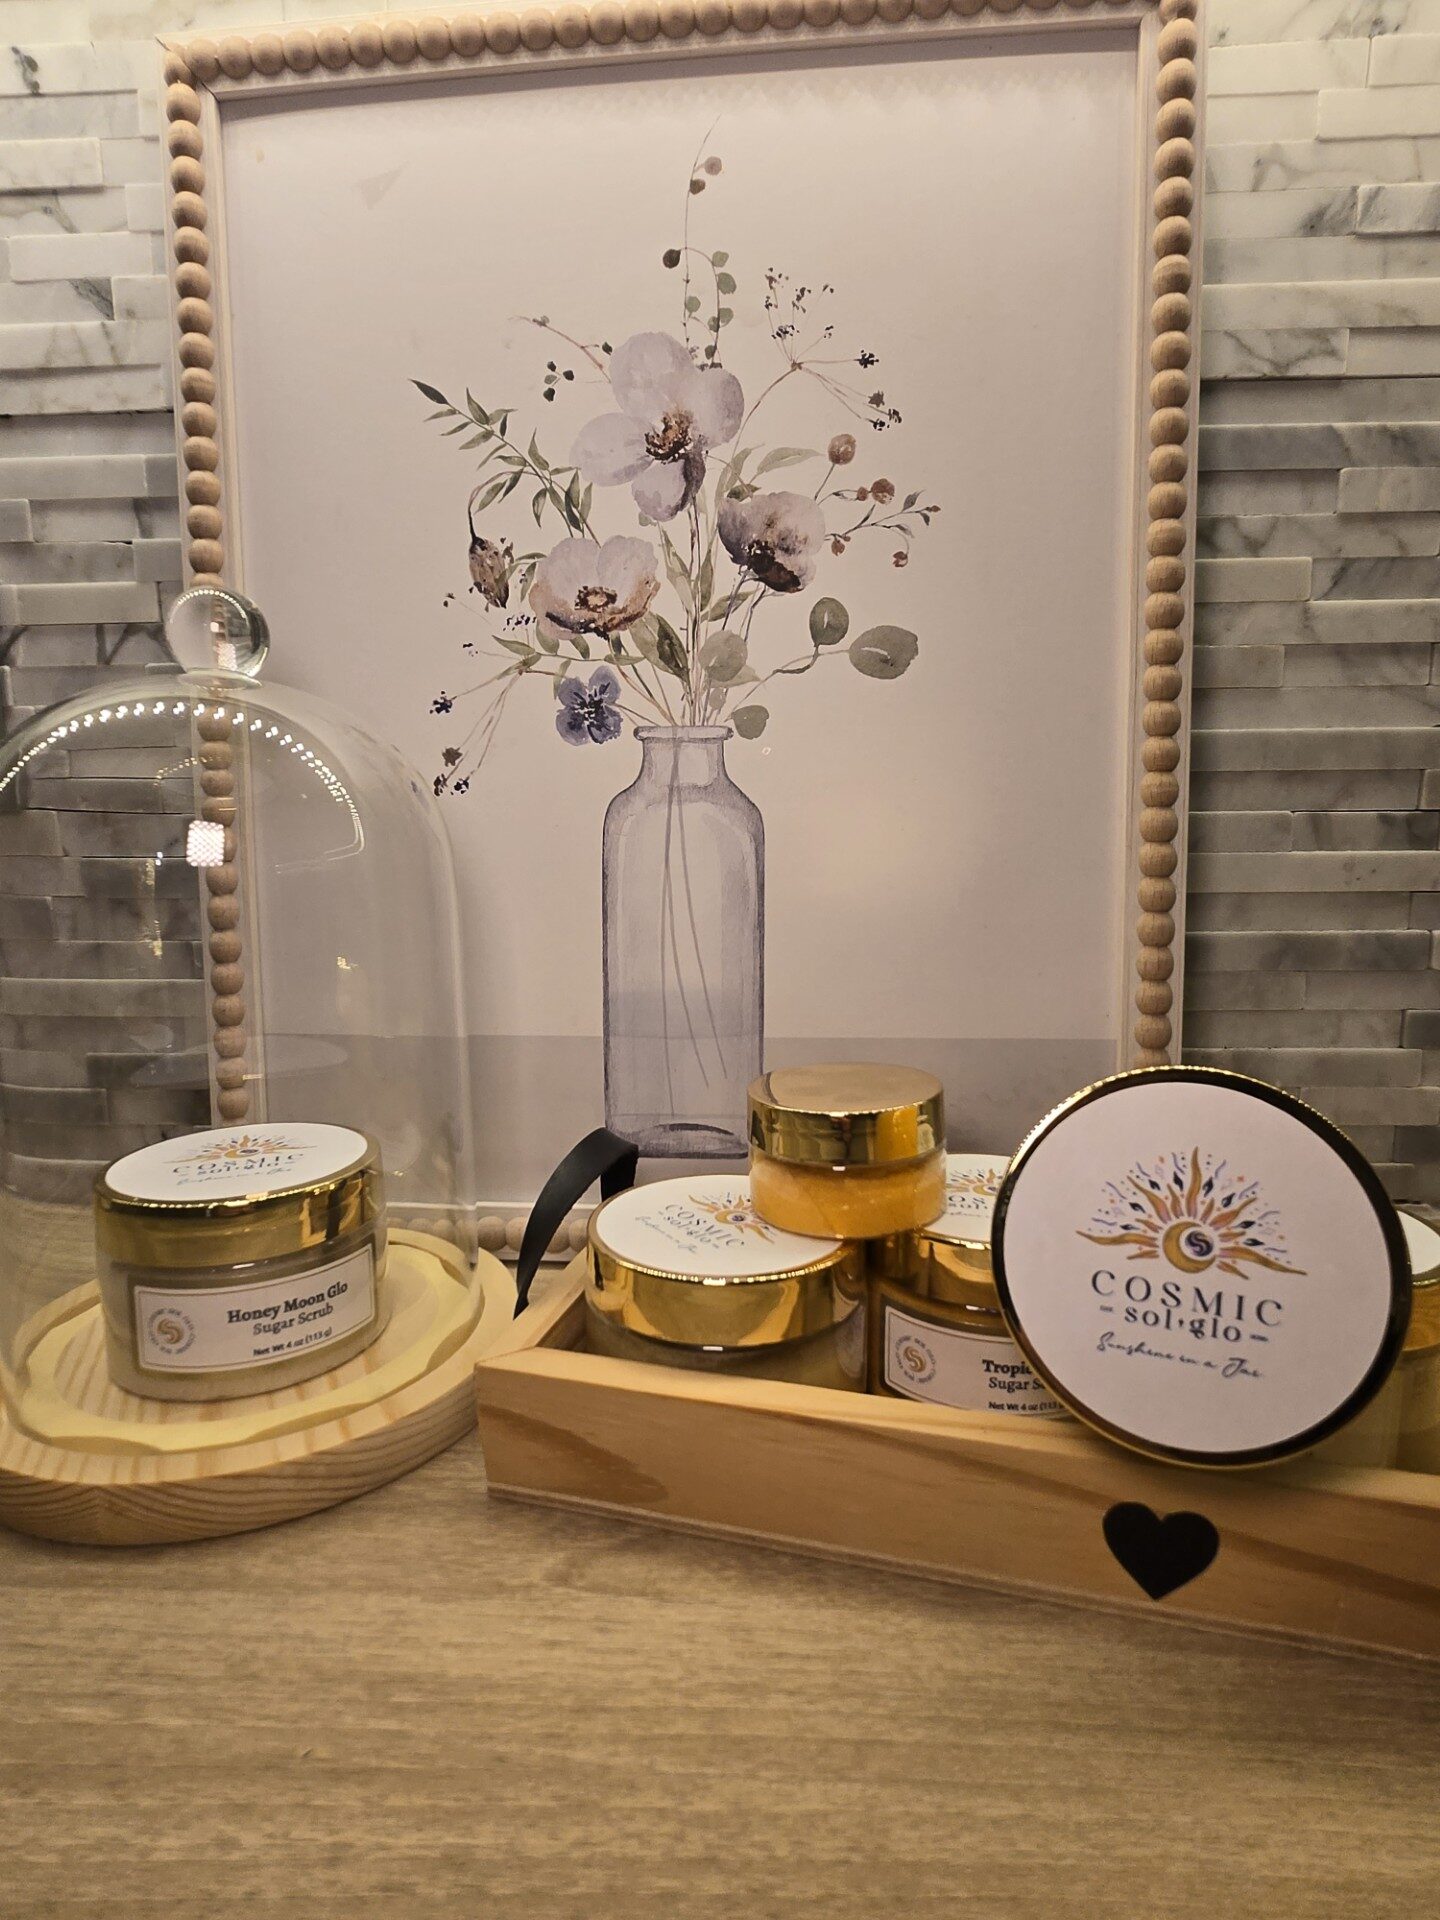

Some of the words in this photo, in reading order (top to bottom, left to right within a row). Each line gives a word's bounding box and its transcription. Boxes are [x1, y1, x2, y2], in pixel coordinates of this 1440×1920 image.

[665, 1204, 745, 1247] COSMIC
[227, 1305, 281, 1323] Honey
[283, 1292, 326, 1313] Moon
[327, 1281, 348, 1299] Glo
[1091, 1270, 1283, 1327] COSMIC
[252, 1317, 296, 1336] Sugar
[298, 1302, 334, 1324] Scrub
[252, 1347, 270, 1357] Net
[272, 1343, 285, 1352] Wt
[286, 1340, 293, 1349] 4
[294, 1338, 304, 1347] oz
[1096, 1331, 1175, 1361] Sunshine
[1179, 1354, 1199, 1365] in
[1221, 1357, 1262, 1379] Jar
[988, 1376, 1031, 1393] Sugar
[988, 1401, 1004, 1411] Net
[1006, 1402, 1019, 1411] Wt
[1020, 1402, 1027, 1411] 4
[1028, 1403, 1038, 1411] oz
